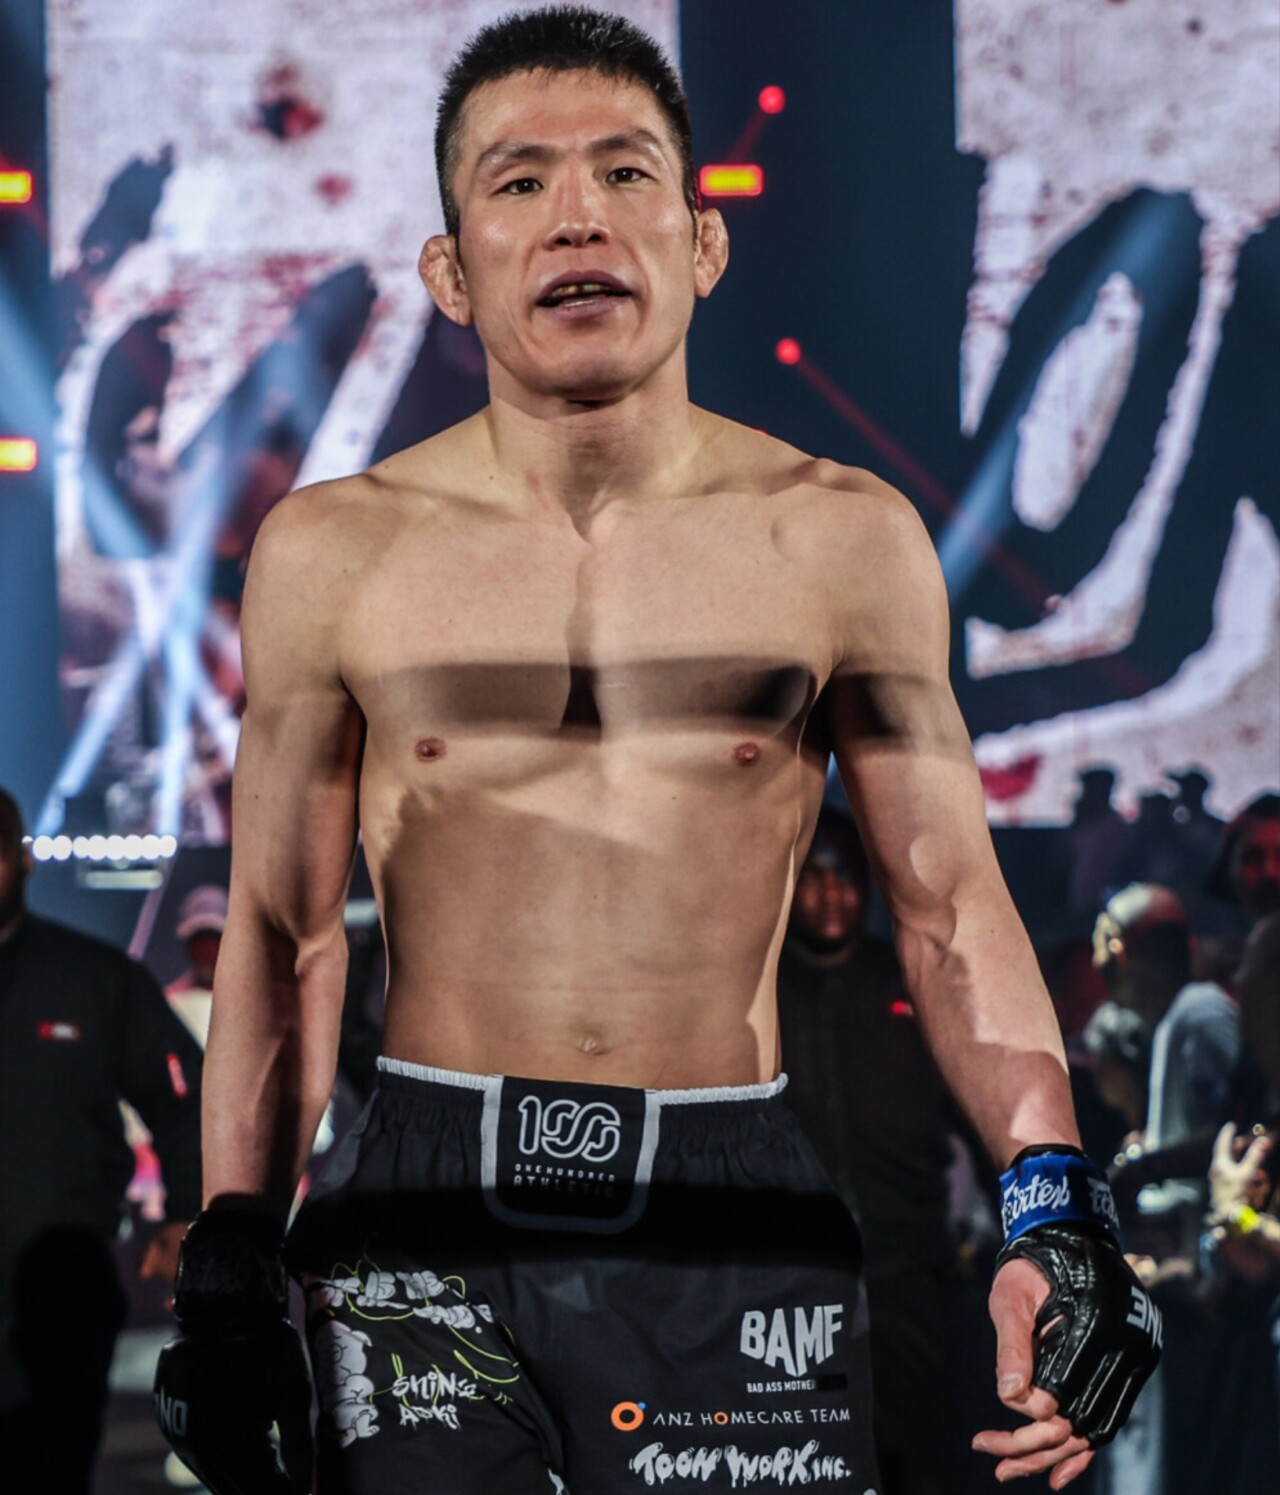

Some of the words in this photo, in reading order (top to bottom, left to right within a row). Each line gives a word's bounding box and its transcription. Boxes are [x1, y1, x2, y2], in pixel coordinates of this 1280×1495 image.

[740, 1304, 843, 1377] BAMF
[747, 1382, 764, 1393] BAD
[766, 1381, 782, 1392] ASS
[652, 1412, 694, 1426] ANZ
[700, 1410, 804, 1425] HOMECARE
[810, 1408, 850, 1423] TEAM
[629, 1441, 722, 1485] TOON
[724, 1439, 819, 1488] WORK
